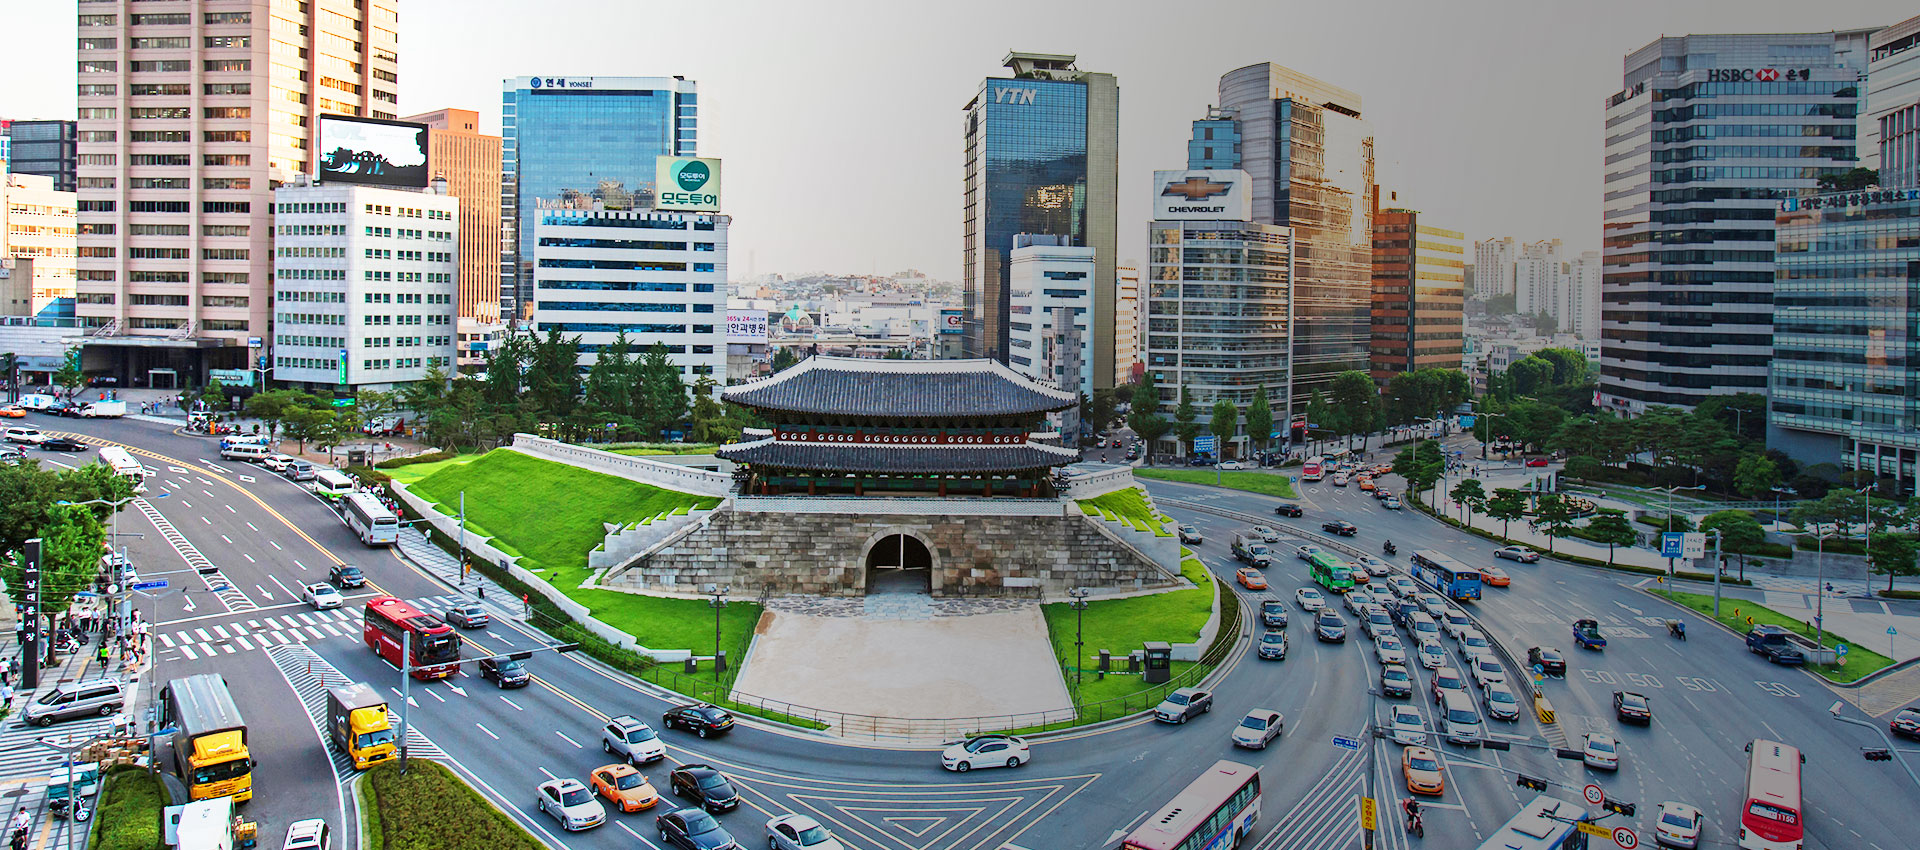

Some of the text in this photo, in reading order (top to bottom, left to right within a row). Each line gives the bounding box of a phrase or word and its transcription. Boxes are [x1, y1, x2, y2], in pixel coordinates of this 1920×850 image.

[545, 78, 566, 88] 연세
[1708, 67, 1811, 83] HSBC 은행
[994, 87, 1037, 105] YTN
[680, 172, 706, 180] 모두투어
[661, 192, 718, 207] 모두투어
[26, 579, 37, 642] 남대문시장
[1579, 668, 1617, 686] 50
[1625, 672, 1664, 689] 50
[1675, 676, 1717, 693] 50
[1754, 680, 1800, 698] 50
[1588, 789, 1600, 800] 50
[1777, 813, 1795, 824] 1150
[1617, 832, 1633, 845] 60
